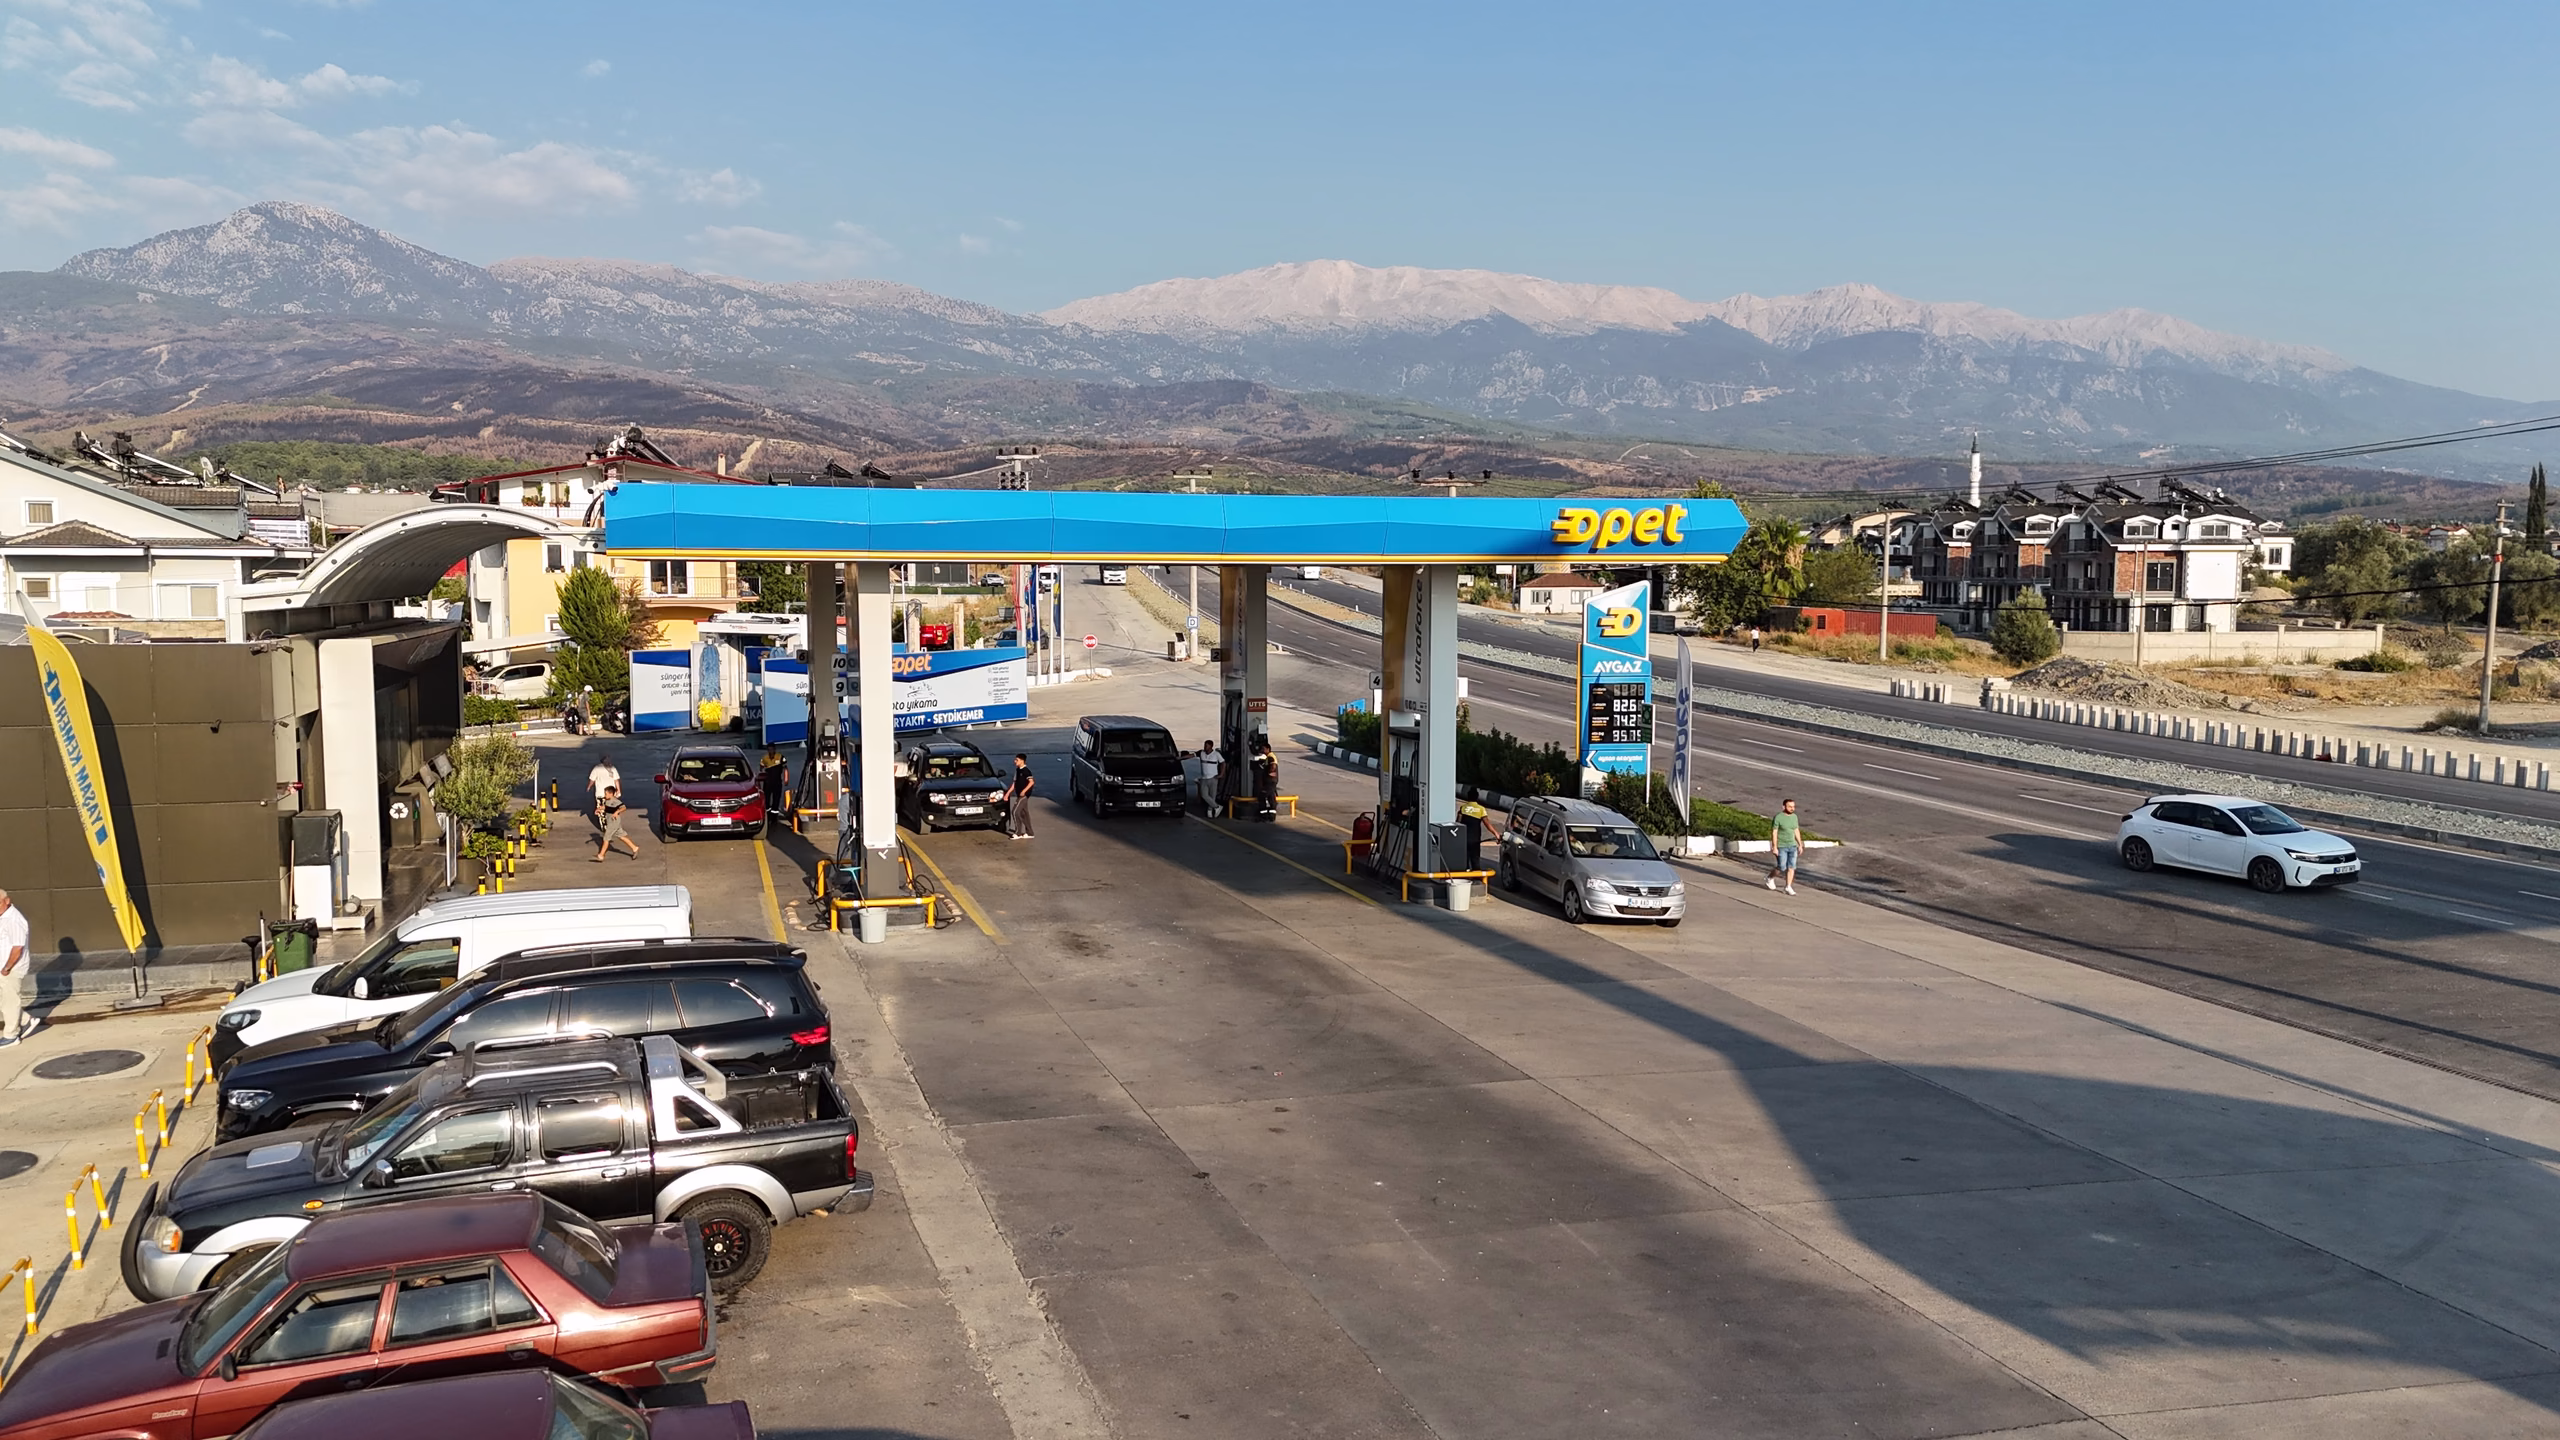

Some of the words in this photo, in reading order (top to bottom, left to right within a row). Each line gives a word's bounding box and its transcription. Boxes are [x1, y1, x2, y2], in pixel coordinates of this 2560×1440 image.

[1551, 503, 1688, 549] opet
[1415, 579, 1423, 684] ultraforce
[798, 652, 805, 660] 6
[1213, 652, 1220, 660] 2
[833, 658, 846, 668] 10
[1593, 660, 1643, 673] AYGAZ
[661, 672, 683, 682] sünger
[1373, 676, 1381, 686] 4
[796, 681, 808, 690] sün
[836, 682, 844, 692] 9
[906, 698, 938, 711] yıkama
[893, 714, 926, 728] RYAKIT
[933, 708, 984, 725] SEYDİKEMER
